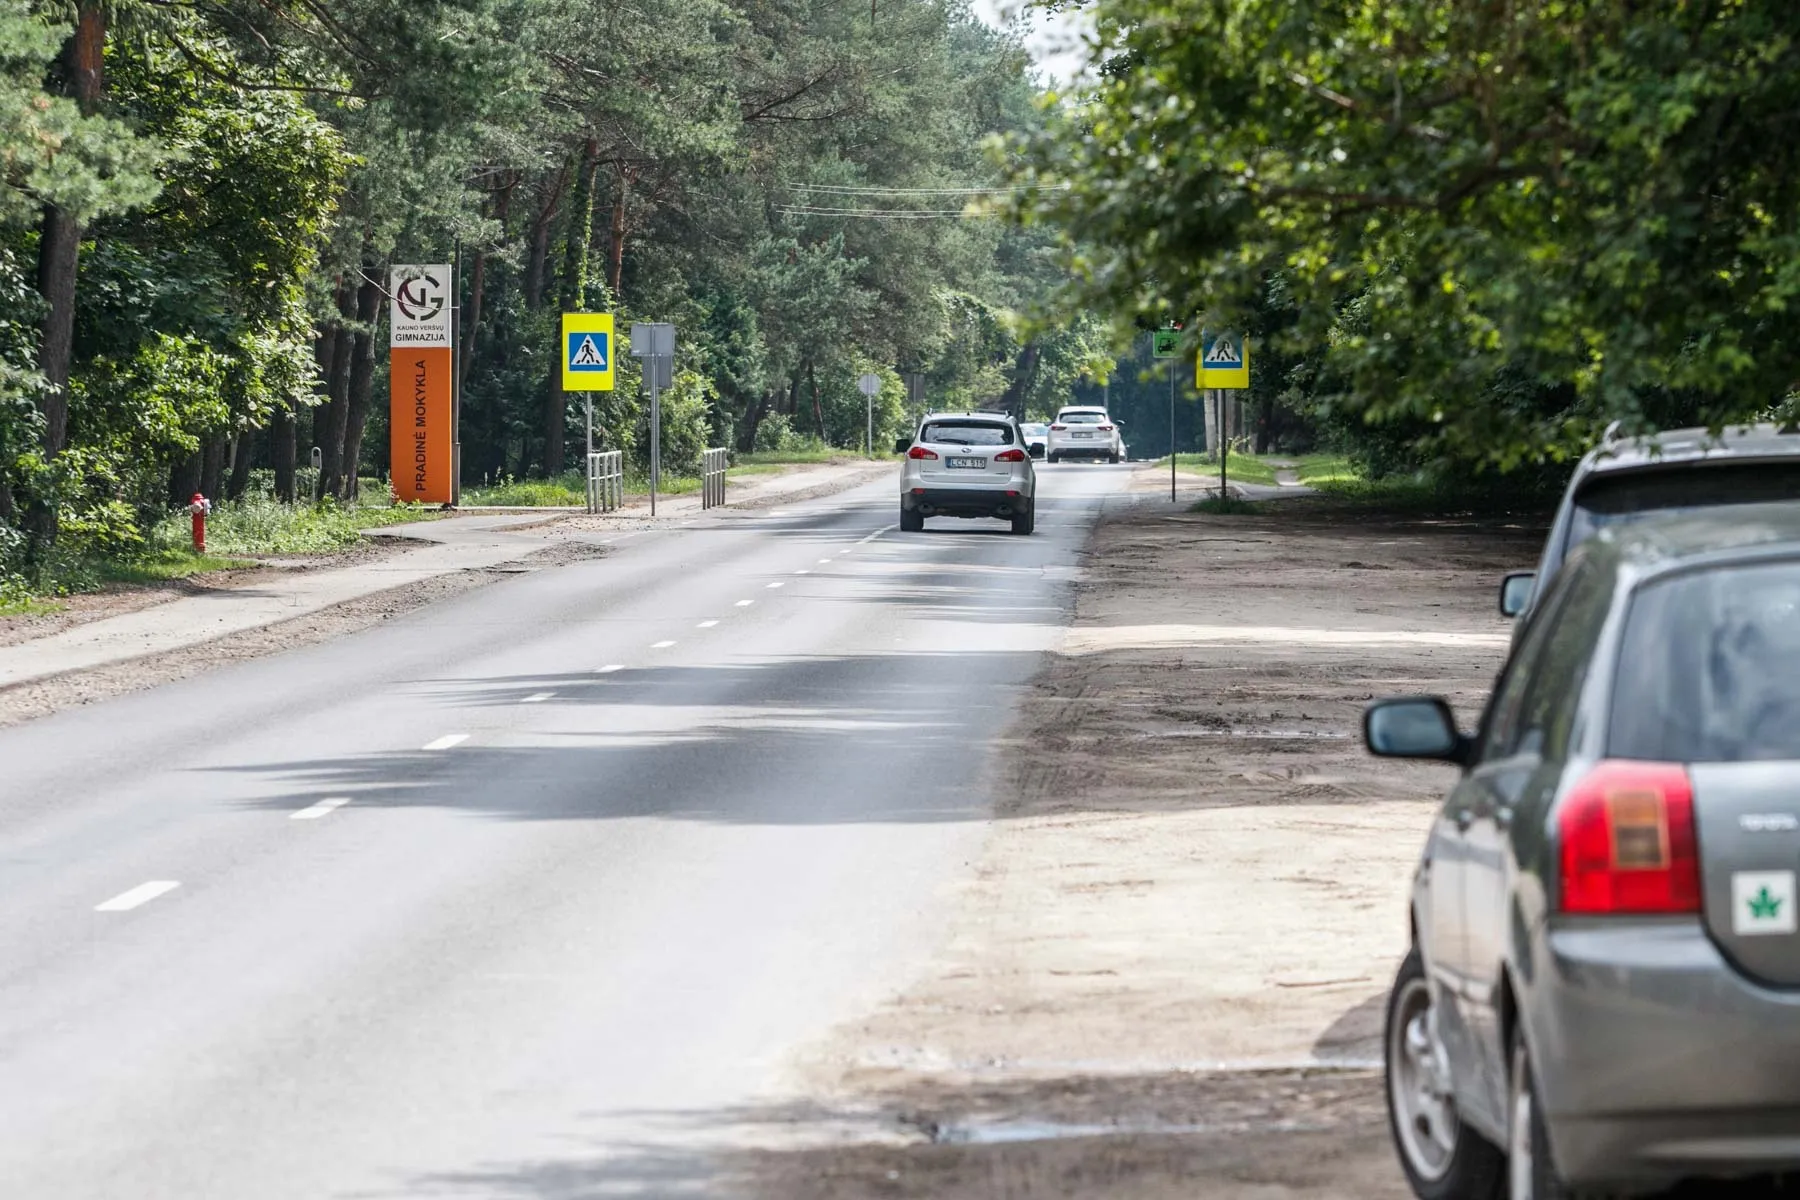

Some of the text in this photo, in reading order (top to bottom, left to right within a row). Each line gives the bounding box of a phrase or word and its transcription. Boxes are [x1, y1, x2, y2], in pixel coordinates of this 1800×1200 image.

[395, 333, 445, 341] GIMNAZIJA
[413, 360, 426, 491] PRADINĖ MOKYKLA
